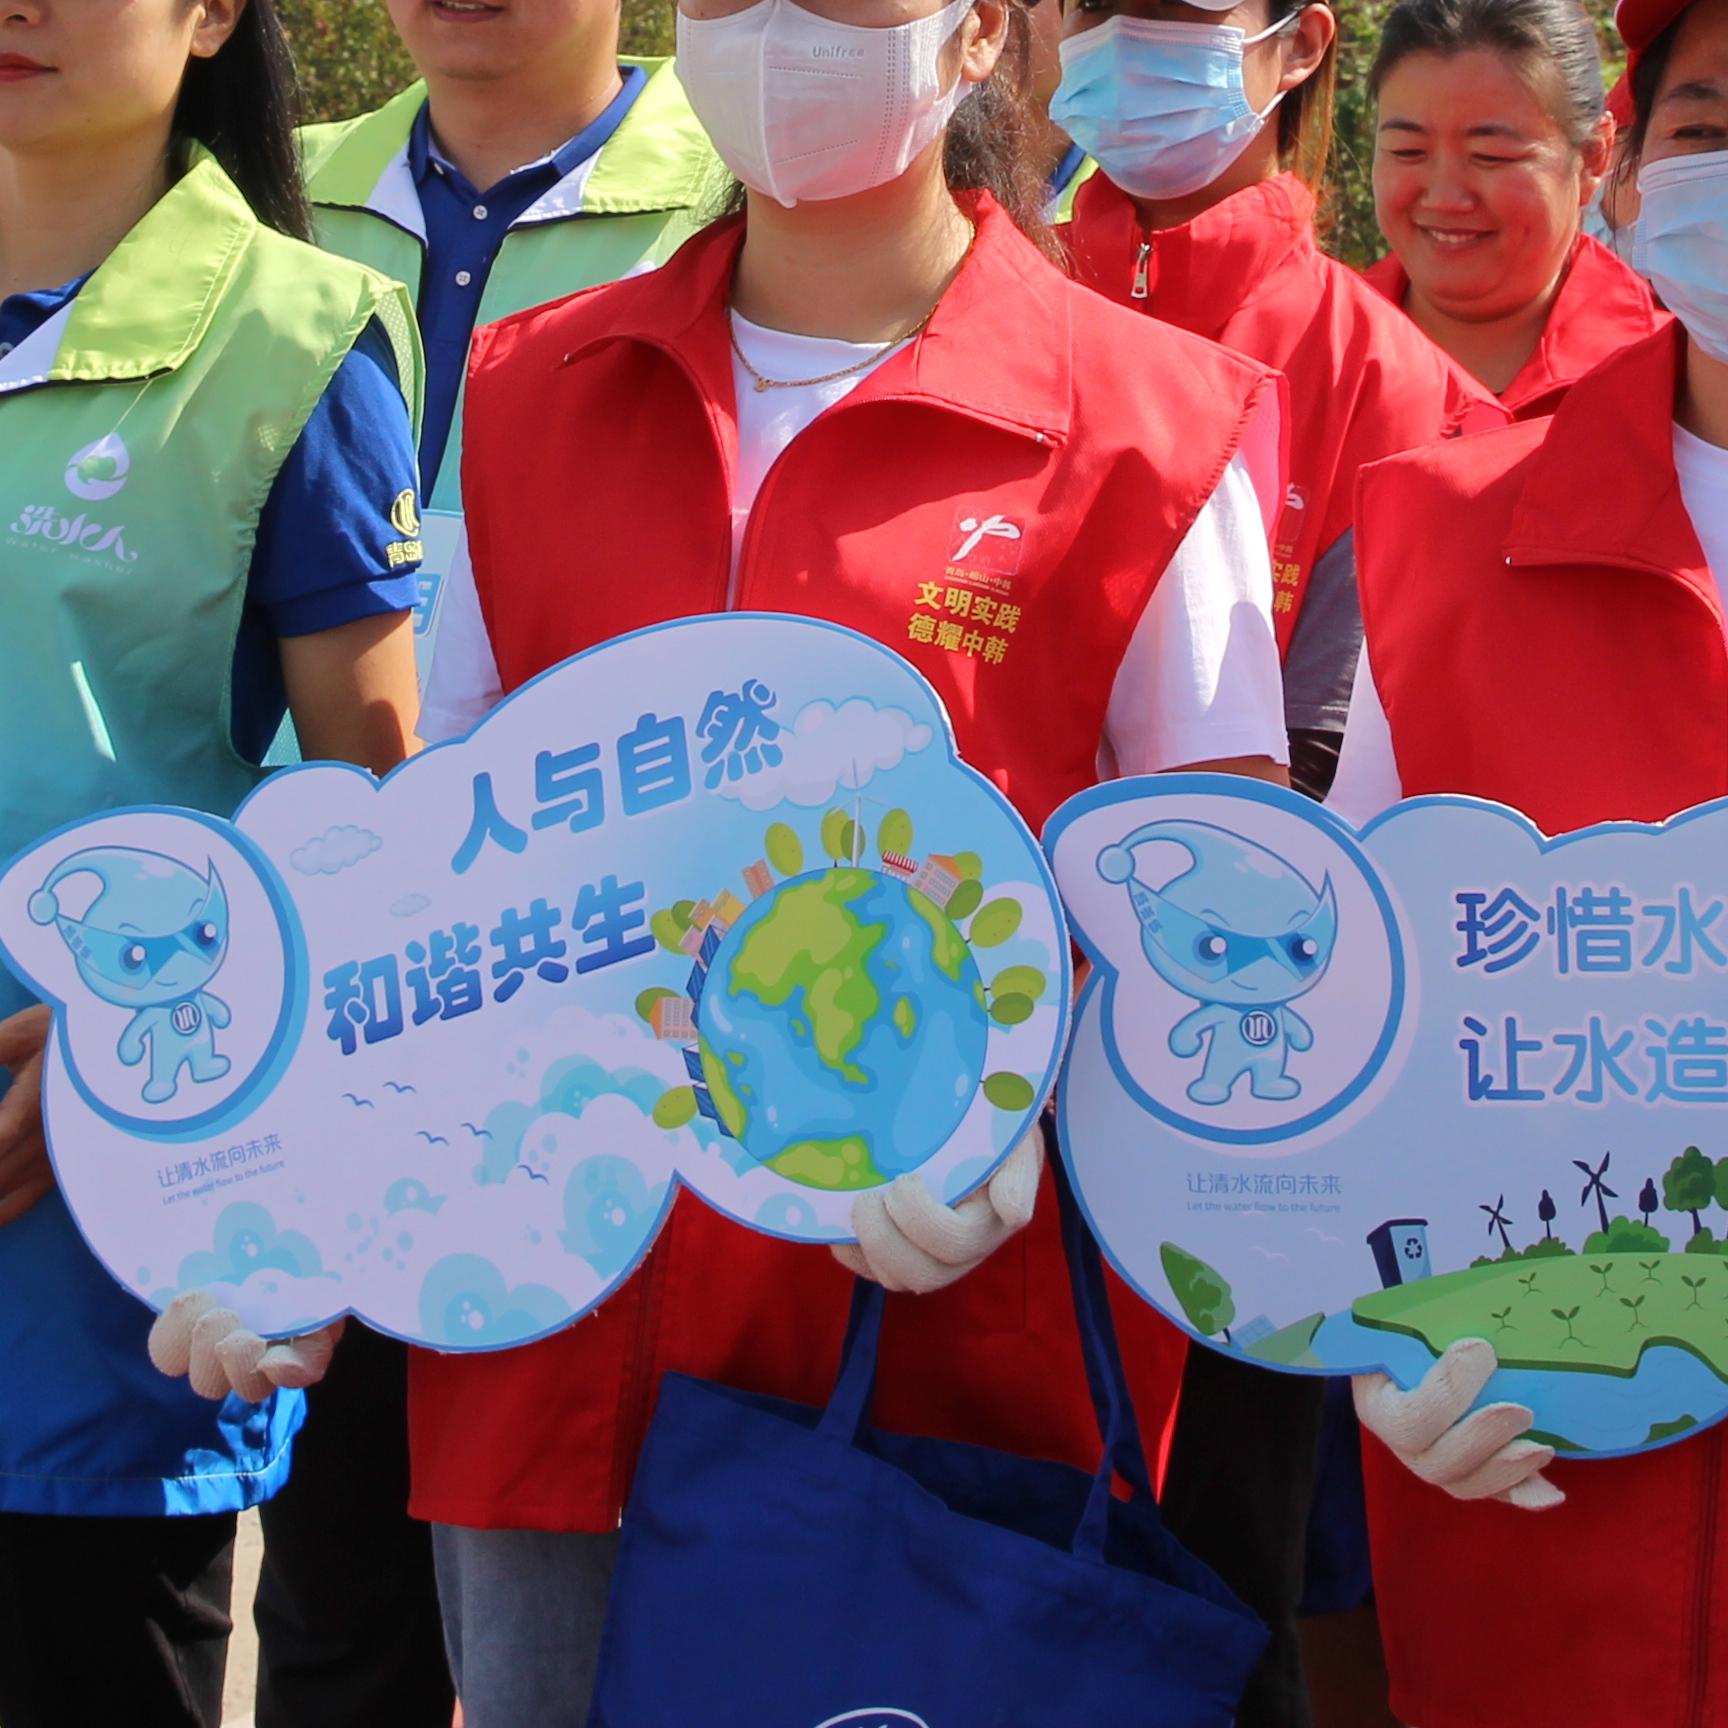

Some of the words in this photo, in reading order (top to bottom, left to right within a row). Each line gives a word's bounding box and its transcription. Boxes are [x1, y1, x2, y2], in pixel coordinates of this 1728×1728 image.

[914, 581, 1021, 633] 文明实践
[907, 613, 1009, 665] 德耀中韩
[451, 679, 783, 875] 人与自然
[324, 874, 656, 1055] 和谐共生
[157, 1133, 283, 1188] 让清水流向未来
[1186, 1172, 1342, 1195] 让清水流向未来
[1187, 1201, 1202, 1211] Let
[1204, 1201, 1221, 1211] the
[1223, 1202, 1252, 1212] water
[1254, 1201, 1276, 1212] flow
[1278, 1202, 1289, 1212] to
[1291, 1202, 1308, 1213] the
[1309, 1202, 1341, 1213] future
